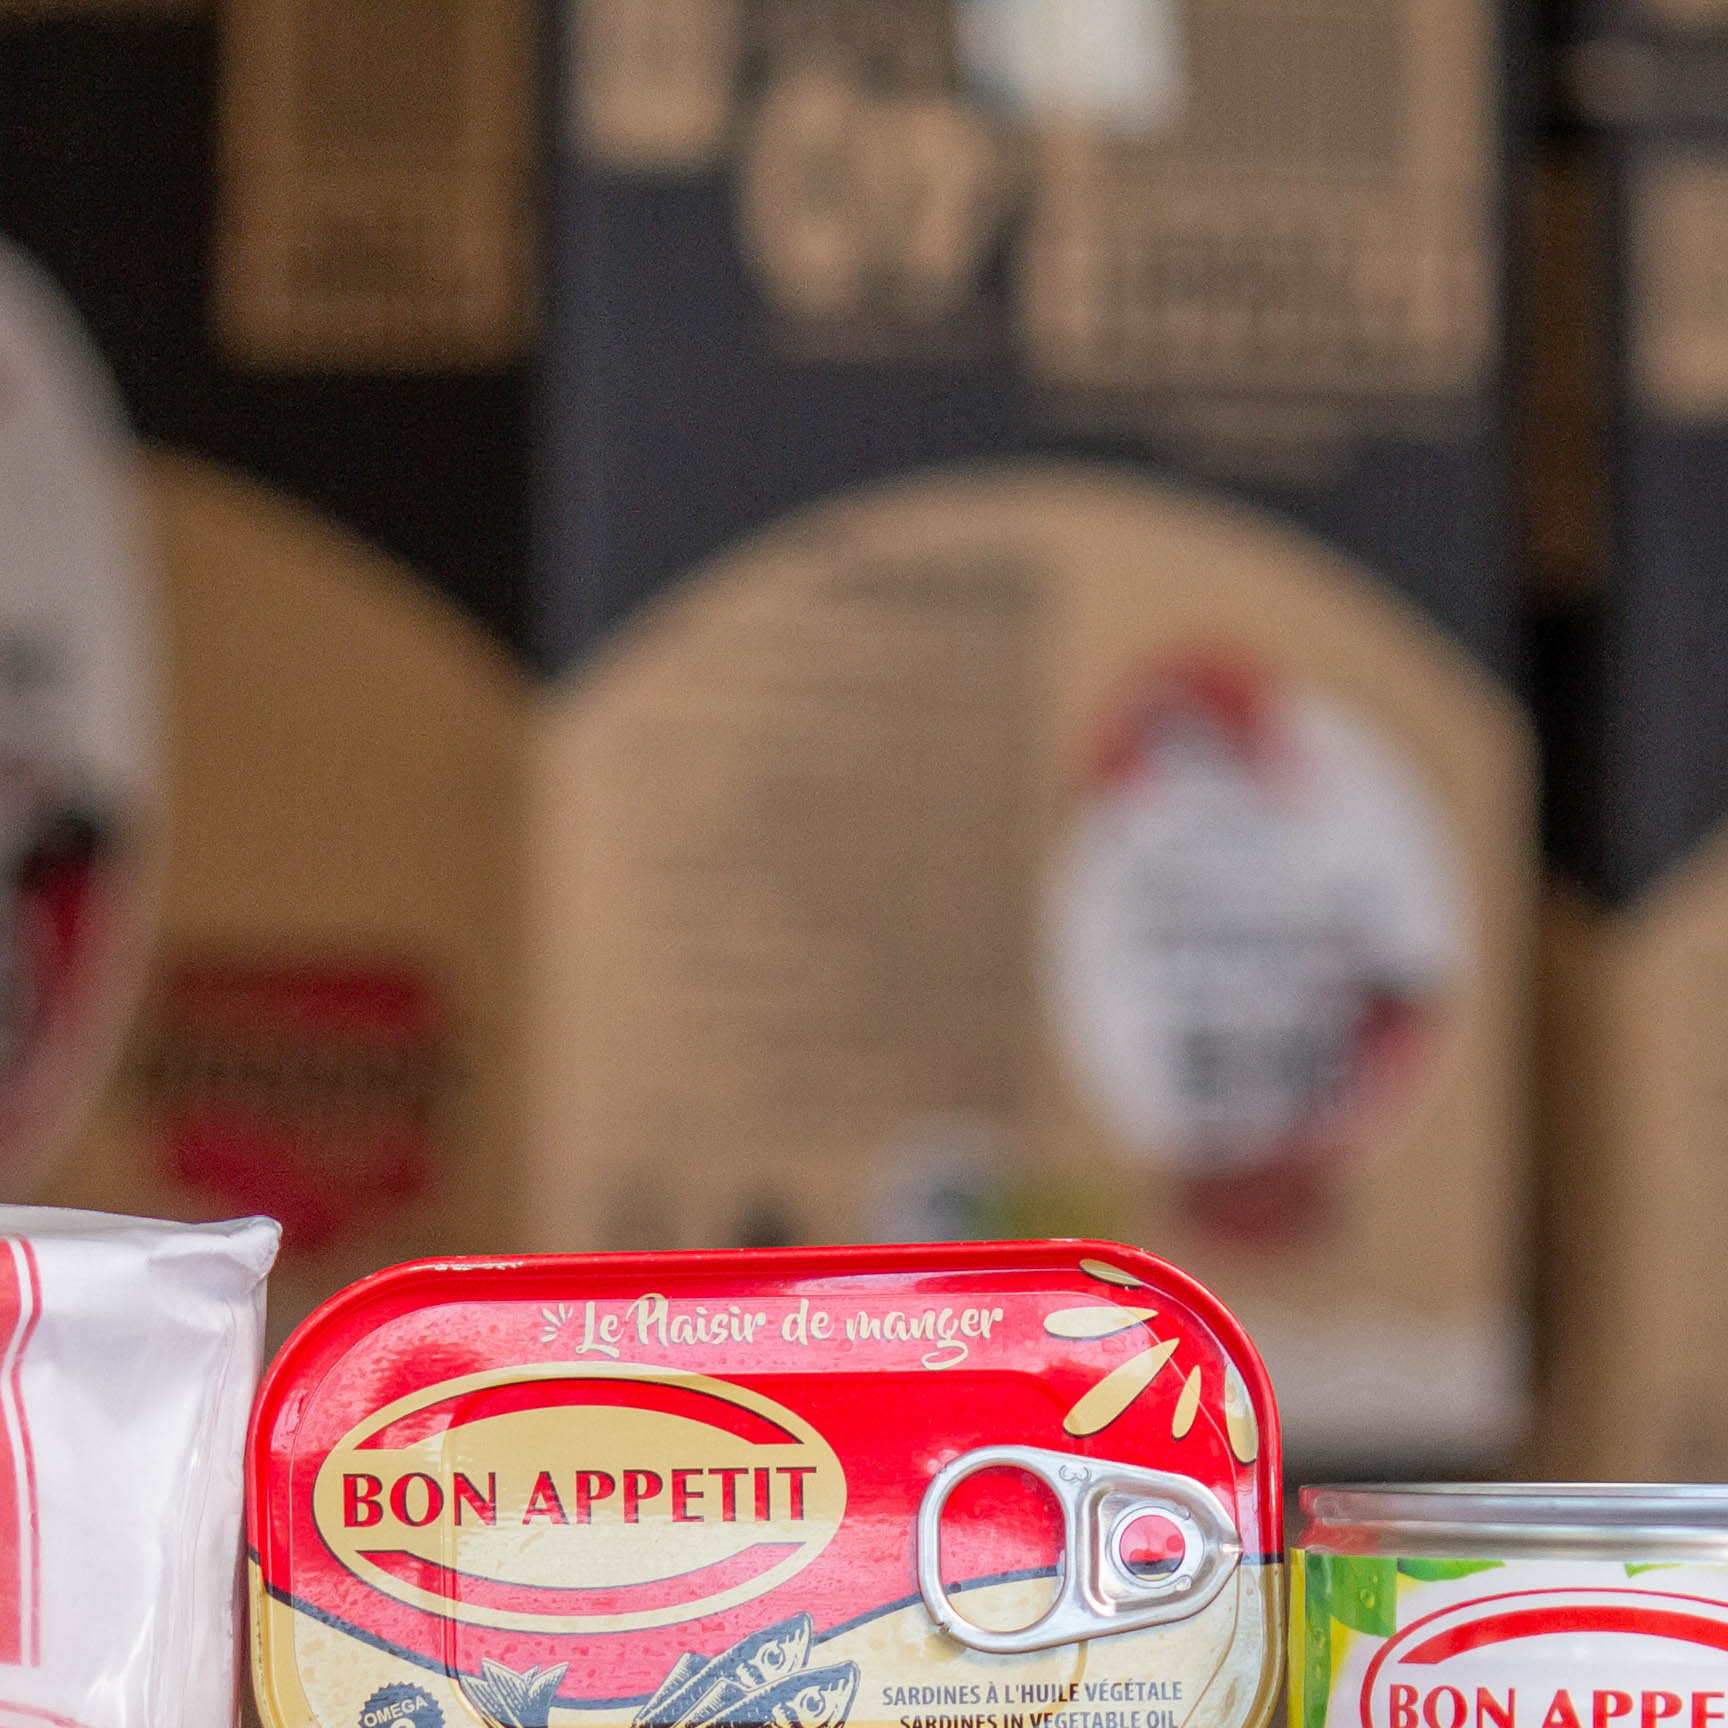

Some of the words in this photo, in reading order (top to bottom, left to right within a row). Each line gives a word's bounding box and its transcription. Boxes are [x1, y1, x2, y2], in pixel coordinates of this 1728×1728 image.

[574, 1297, 623, 1358] Le
[624, 1293, 768, 1349] Plaisir
[782, 1298, 834, 1345] de
[844, 1304, 1005, 1371] manger
[342, 1470, 498, 1529] BON
[520, 1466, 818, 1526] APPETIT
[363, 1695, 429, 1728] OMEGA
[882, 1684, 981, 1706] SARDINES
[985, 1681, 998, 1704] À
[1004, 1682, 1080, 1704] L'HUILE
[1084, 1679, 1183, 1702] VÉGÉTALE
